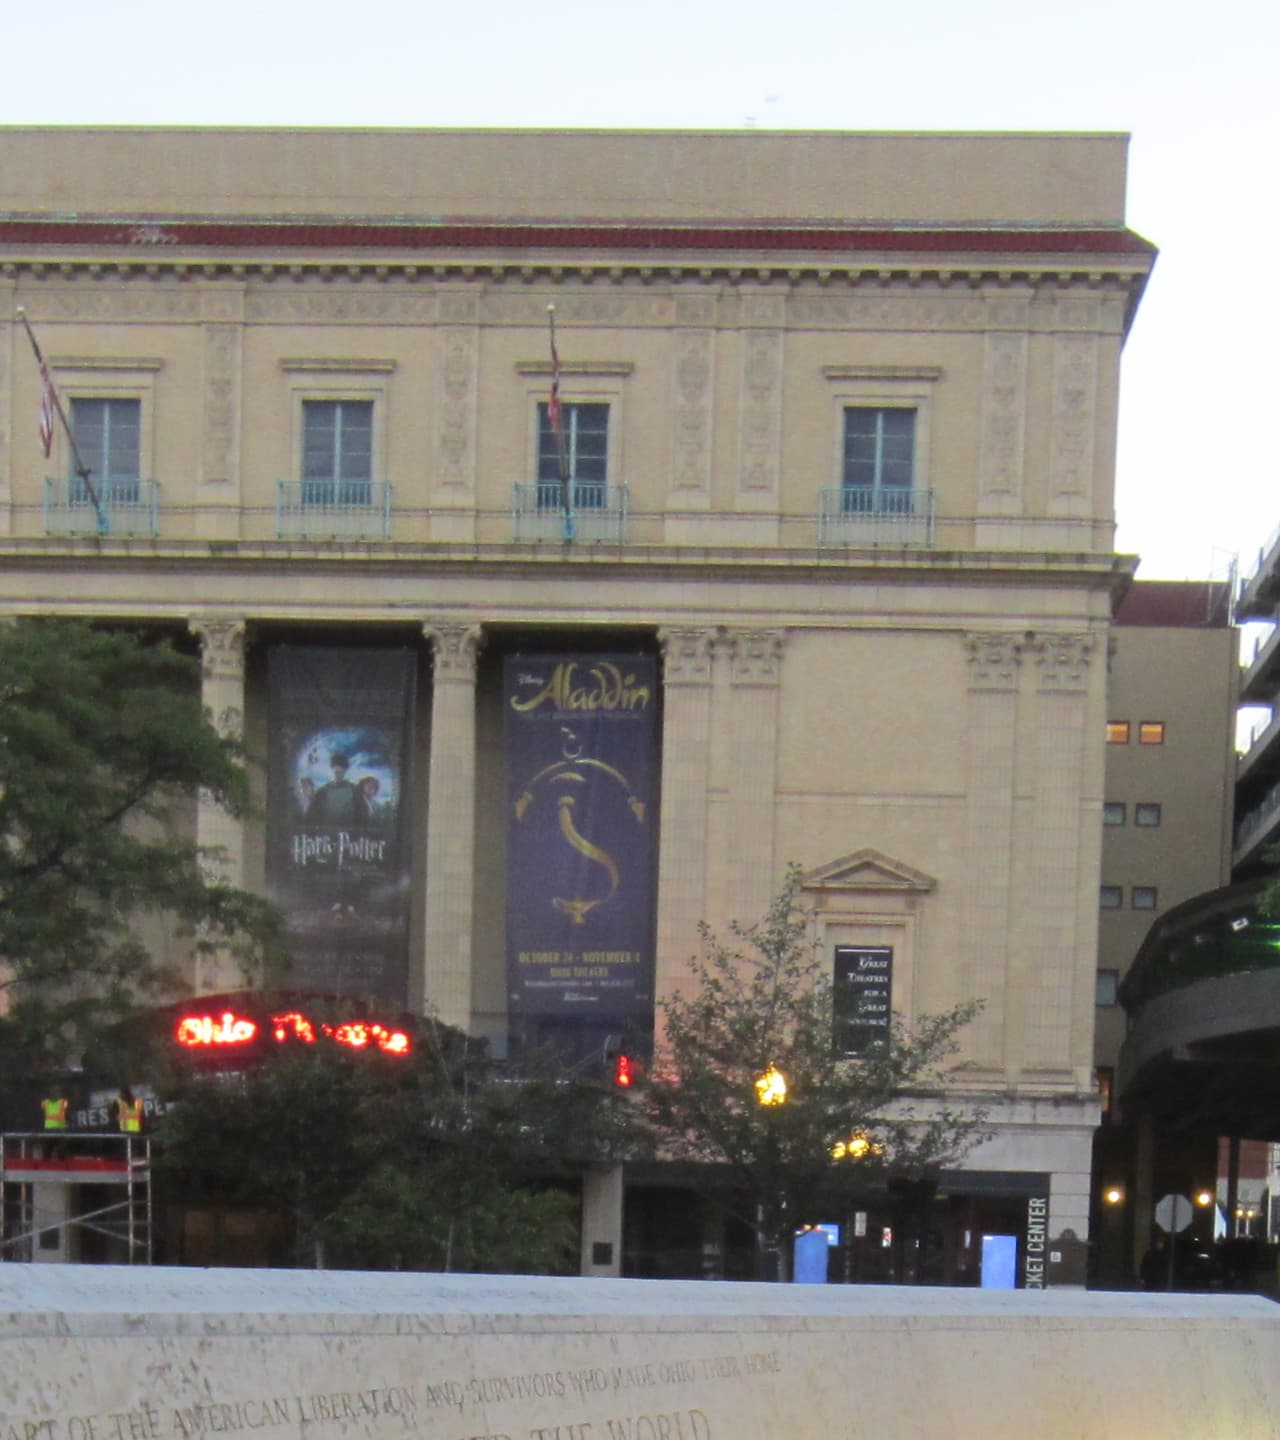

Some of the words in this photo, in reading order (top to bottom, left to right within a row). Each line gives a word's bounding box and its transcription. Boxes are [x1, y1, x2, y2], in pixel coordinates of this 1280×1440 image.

[510, 661, 651, 711] Aladdin
[291, 832, 333, 865] Harry
[337, 831, 386, 868] Potter
[175, 1011, 258, 1048] Ohio
[1026, 1198, 1047, 1252] CENTER
[164, 1398, 291, 1440] AMERICAN
[297, 1384, 417, 1426] LIBERATION
[425, 1379, 465, 1407] AND
[470, 1371, 566, 1405] SURVIVORS
[571, 1367, 608, 1396] WHO
[613, 1363, 656, 1390] MADE
